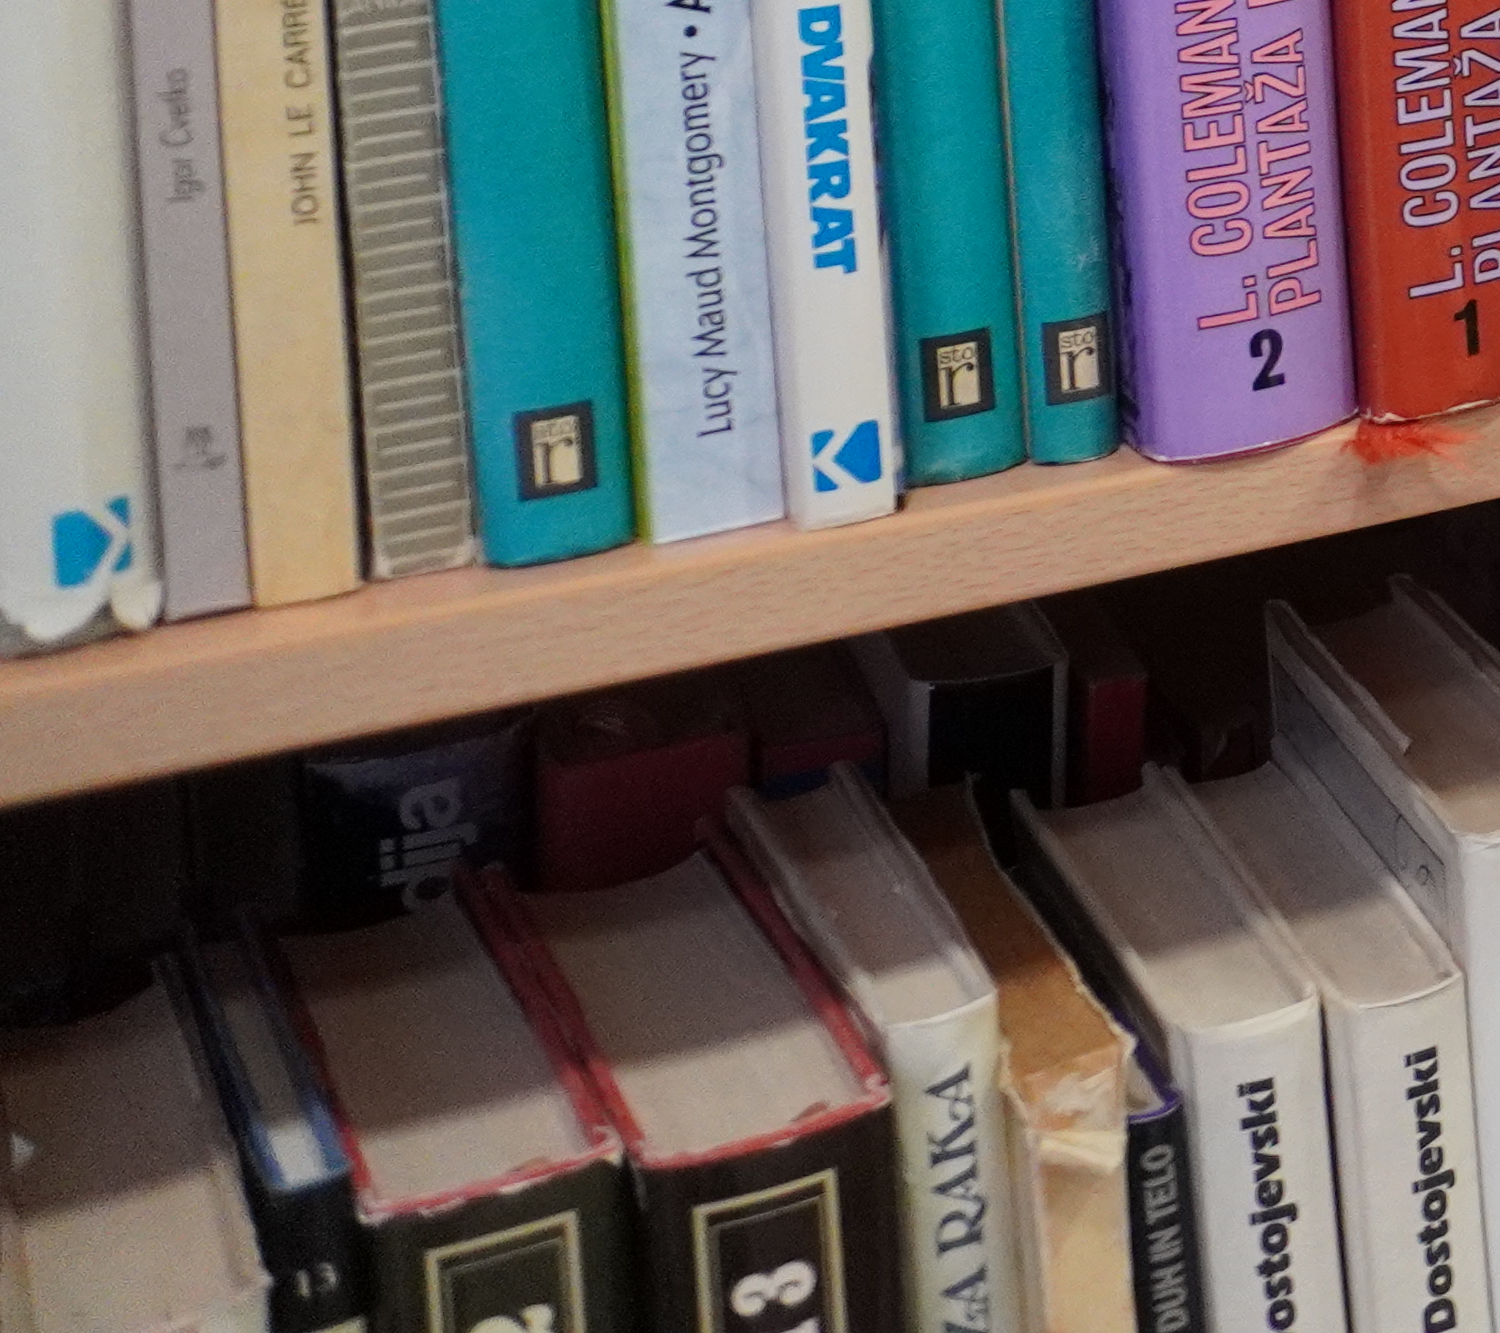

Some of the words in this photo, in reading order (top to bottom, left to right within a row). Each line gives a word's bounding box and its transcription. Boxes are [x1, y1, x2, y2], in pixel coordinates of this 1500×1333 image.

[671, 50, 726, 260] Montgomery
[797, 4, 860, 274] DVAKRAT
[1245, 32, 1324, 313] PLANTAŽA
[685, 263, 726, 358] Maud
[1409, 245, 1465, 300] L.
[693, 365, 740, 438] Lucy
[925, 1064, 981, 1258] RAKA
[1405, 1045, 1456, 1333] Dostojevski
